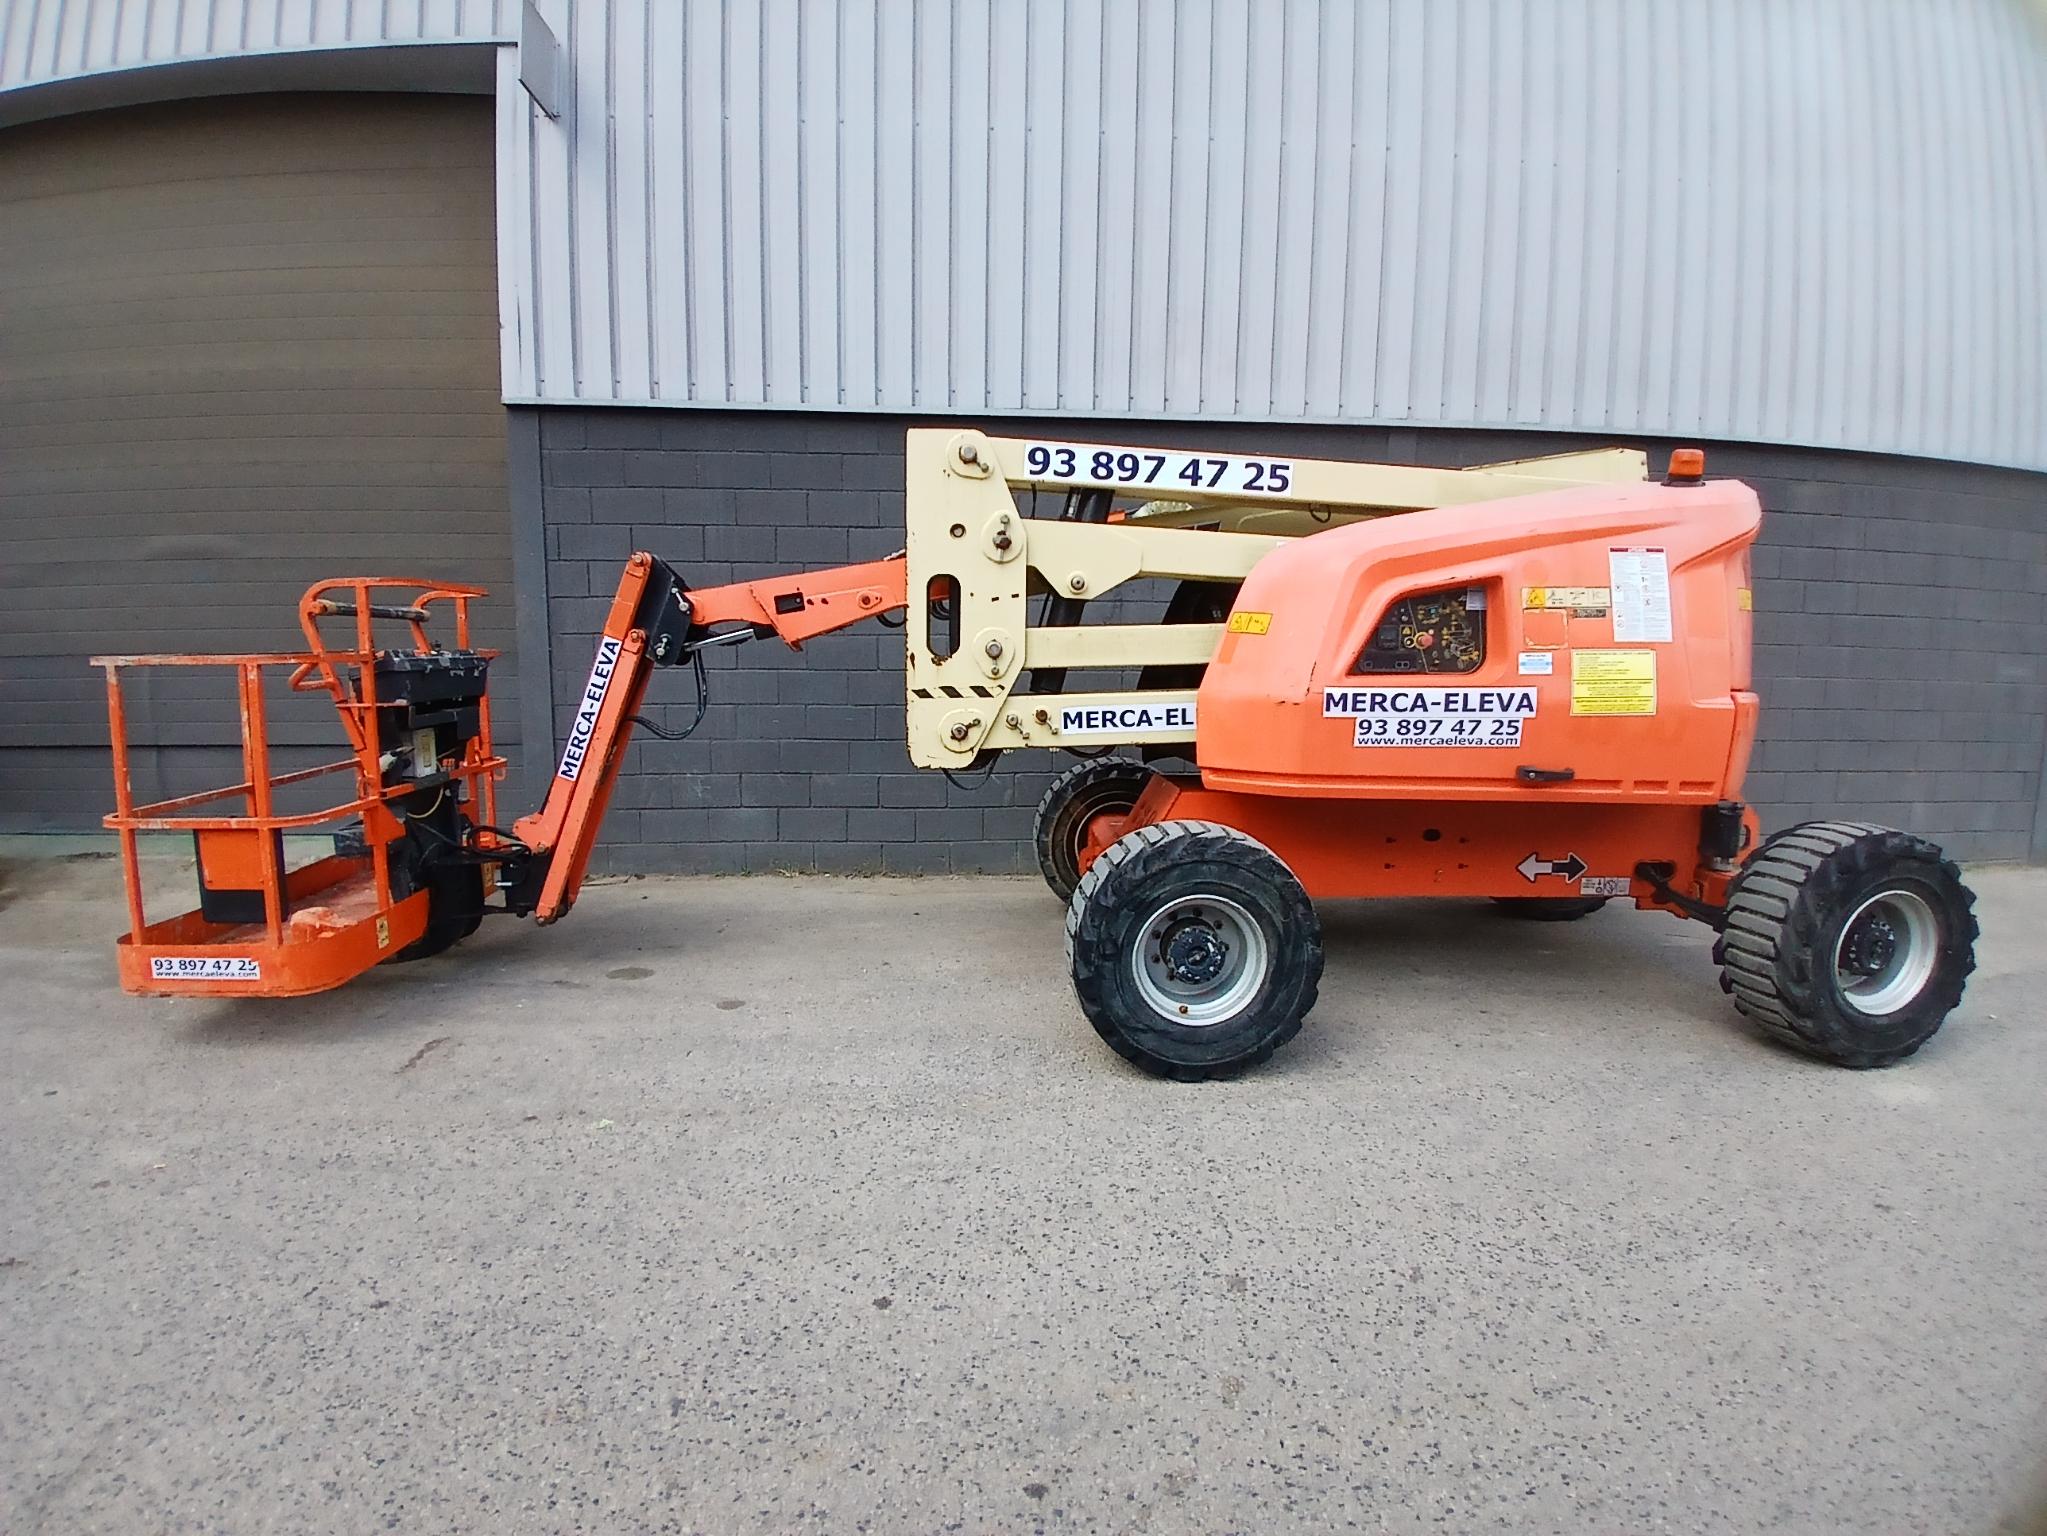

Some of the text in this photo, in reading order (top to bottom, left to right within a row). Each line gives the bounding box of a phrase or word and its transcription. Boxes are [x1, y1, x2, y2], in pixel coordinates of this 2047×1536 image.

[1027, 446, 1290, 493] 93 897 47 25
[560, 640, 620, 779] MERCA-ELEVA
[1325, 692, 1535, 713] MERCA-ELEVA
[1358, 719, 1520, 736] 93 897 47 25
[1357, 735, 1519, 746] www.mercaeleva.com
[154, 959, 174, 971] 93
[178, 959, 207, 971] 897
[212, 960, 231, 971] 47
